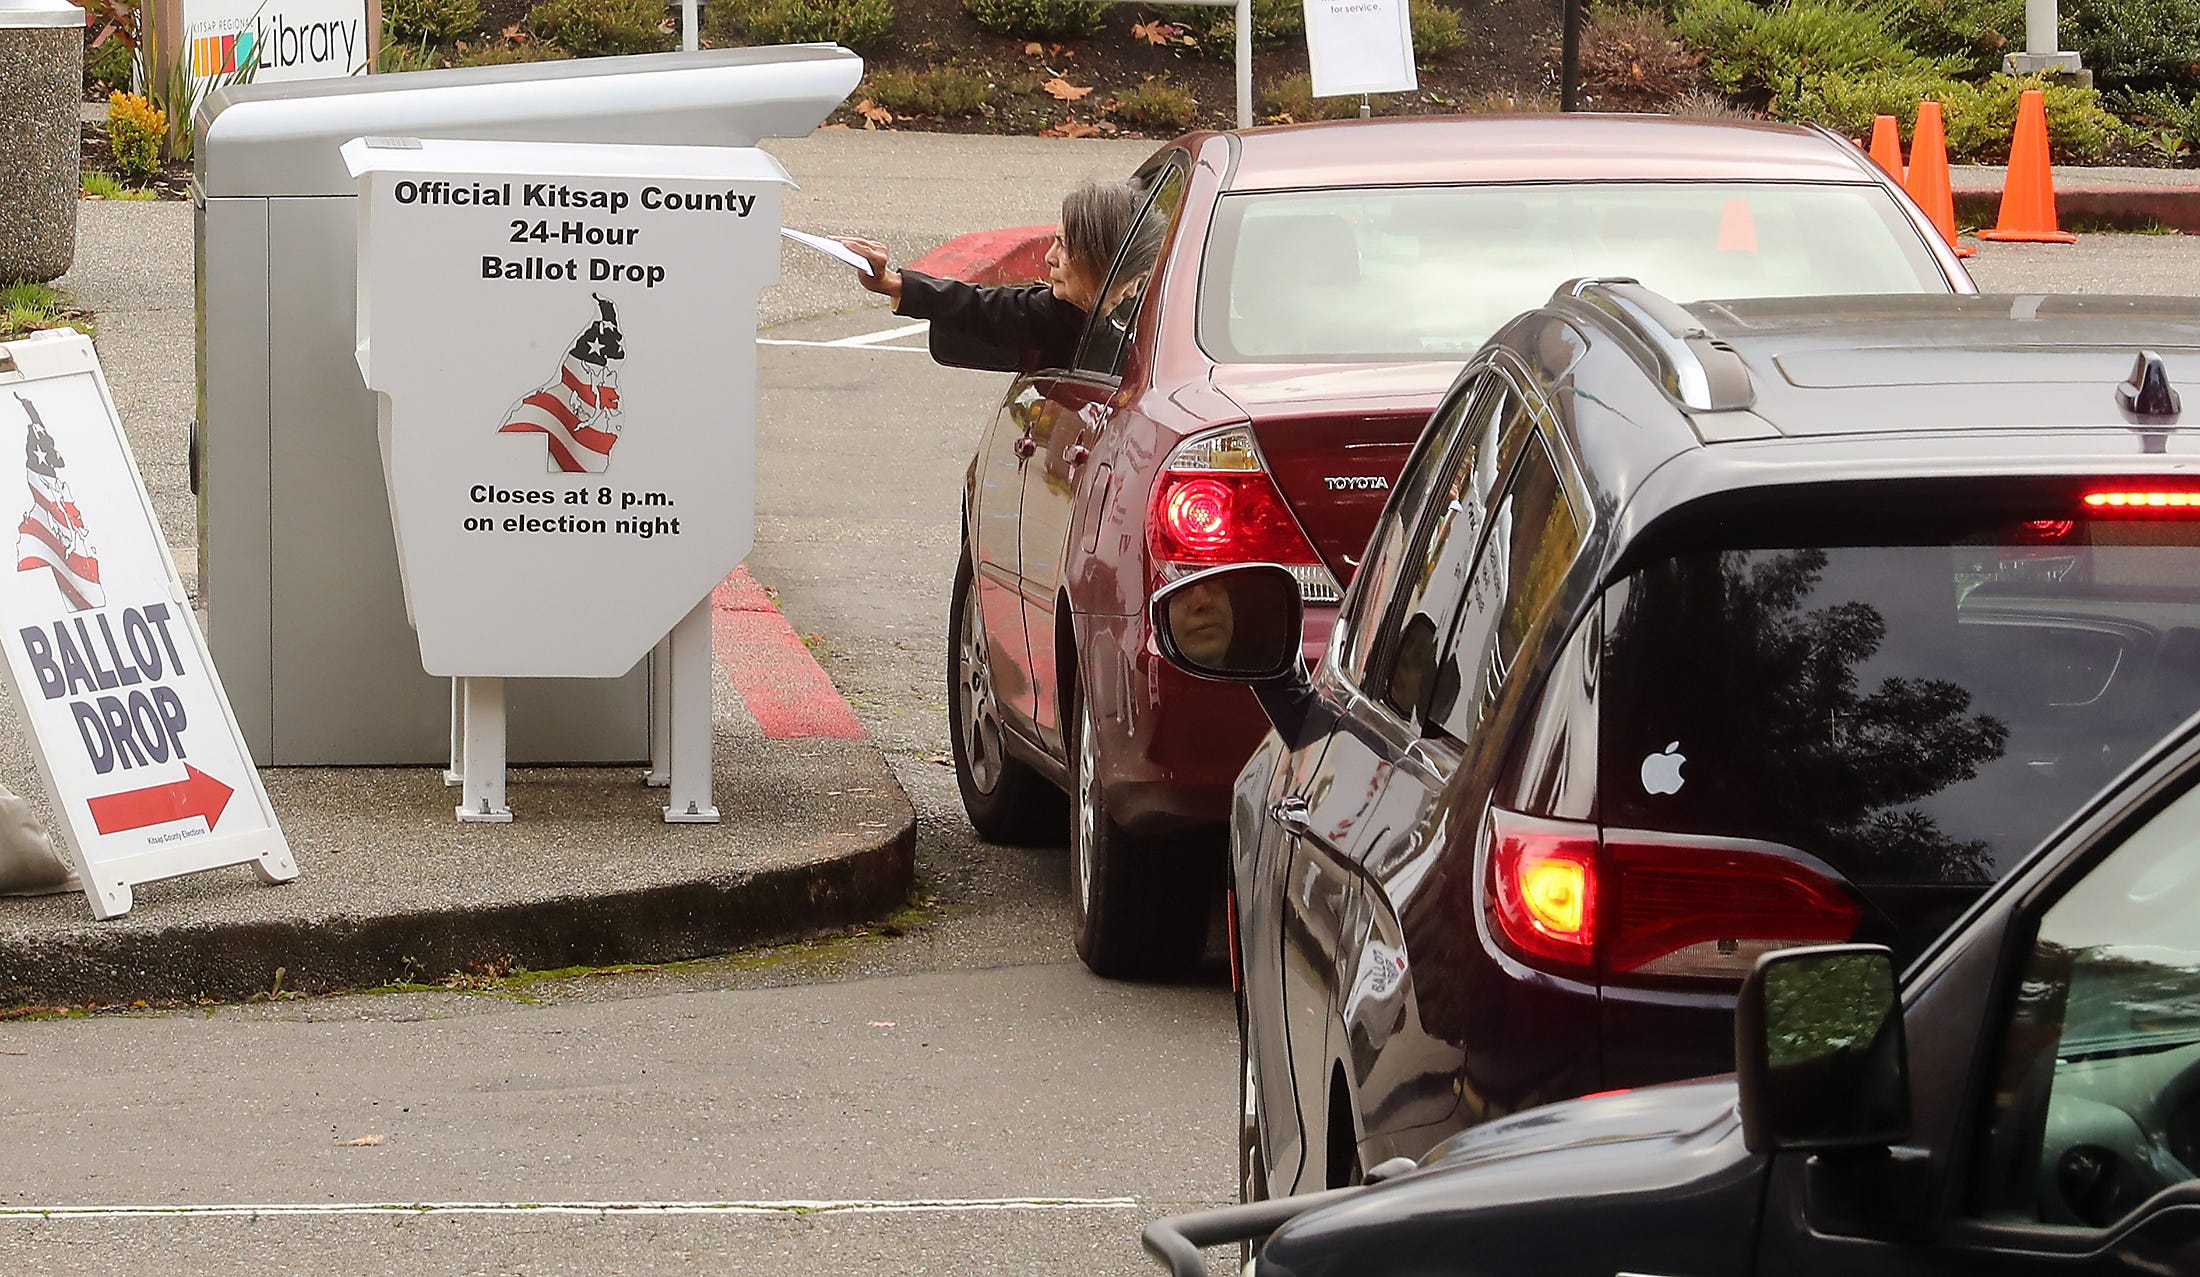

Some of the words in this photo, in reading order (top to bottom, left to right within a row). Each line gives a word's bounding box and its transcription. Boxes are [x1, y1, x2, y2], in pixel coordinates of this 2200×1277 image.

[1345, 3, 1381, 13] service.
[193, 20, 216, 33] KITSAP
[257, 14, 357, 73] Library
[394, 181, 511, 206] Official
[523, 184, 630, 214] Kitsap
[640, 187, 756, 217] County
[510, 220, 640, 246] 24-Hour
[482, 256, 578, 281] Ballot
[589, 258, 666, 287] Drop
[1324, 476, 1389, 490] TOYOTA
[470, 485, 555, 504] Closes
[564, 488, 588, 504] at
[597, 487, 612, 505] 8
[621, 492, 674, 509] p.m.
[463, 517, 494, 531] on
[502, 514, 606, 533] election
[615, 516, 680, 538] night
[19, 603, 185, 700] BALLOT
[69, 686, 187, 774] DROP
[163, 832, 182, 841] County
[181, 829, 205, 838] Elections
